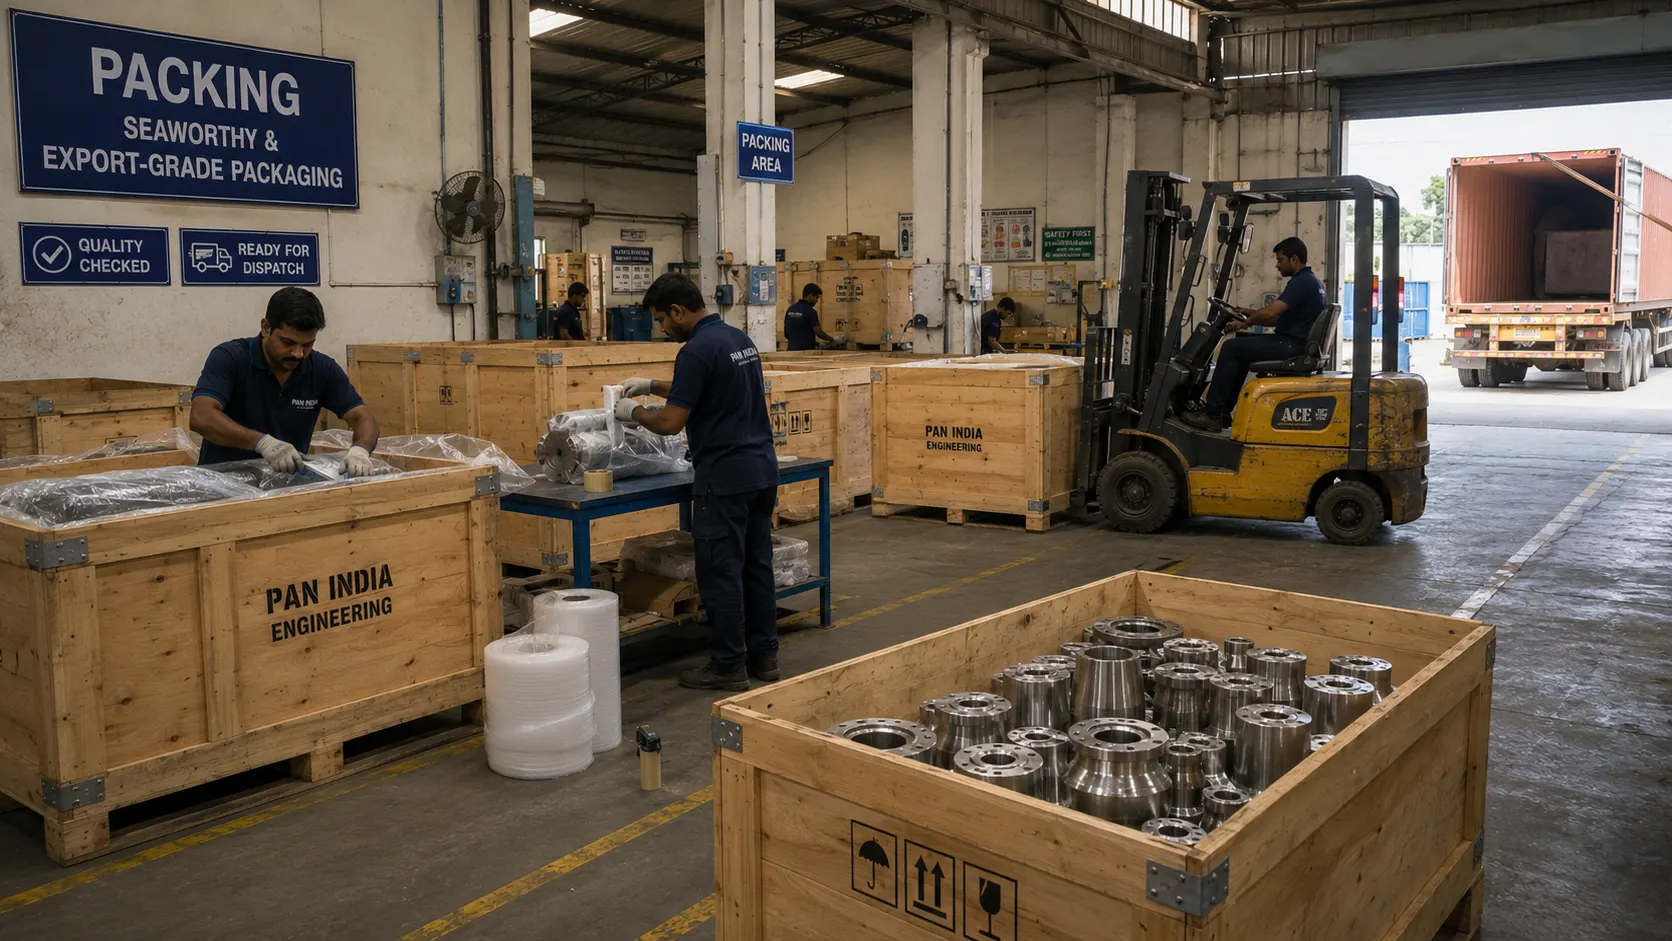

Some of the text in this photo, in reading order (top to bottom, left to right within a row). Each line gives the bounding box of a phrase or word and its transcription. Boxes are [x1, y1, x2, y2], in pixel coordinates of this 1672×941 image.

[91, 46, 300, 116] PACKING
[123, 115, 279, 152] SEAWORTHY &
[742, 132, 790, 153] PACKING
[42, 145, 343, 189] EXPORT-GRADE PACKAGING
[751, 155, 782, 173] AREA
[78, 237, 144, 254] QUALITY
[238, 242, 310, 258] READY FOR
[79, 258, 151, 274] CHECKED
[243, 261, 305, 276] DISPATCH
[1281, 407, 1312, 422] ACE
[925, 425, 983, 440] PAN INDIA
[926, 440, 983, 453] ENGINEERING
[266, 563, 394, 615] PAN INDIA
[271, 596, 393, 643] ENGINEERING
